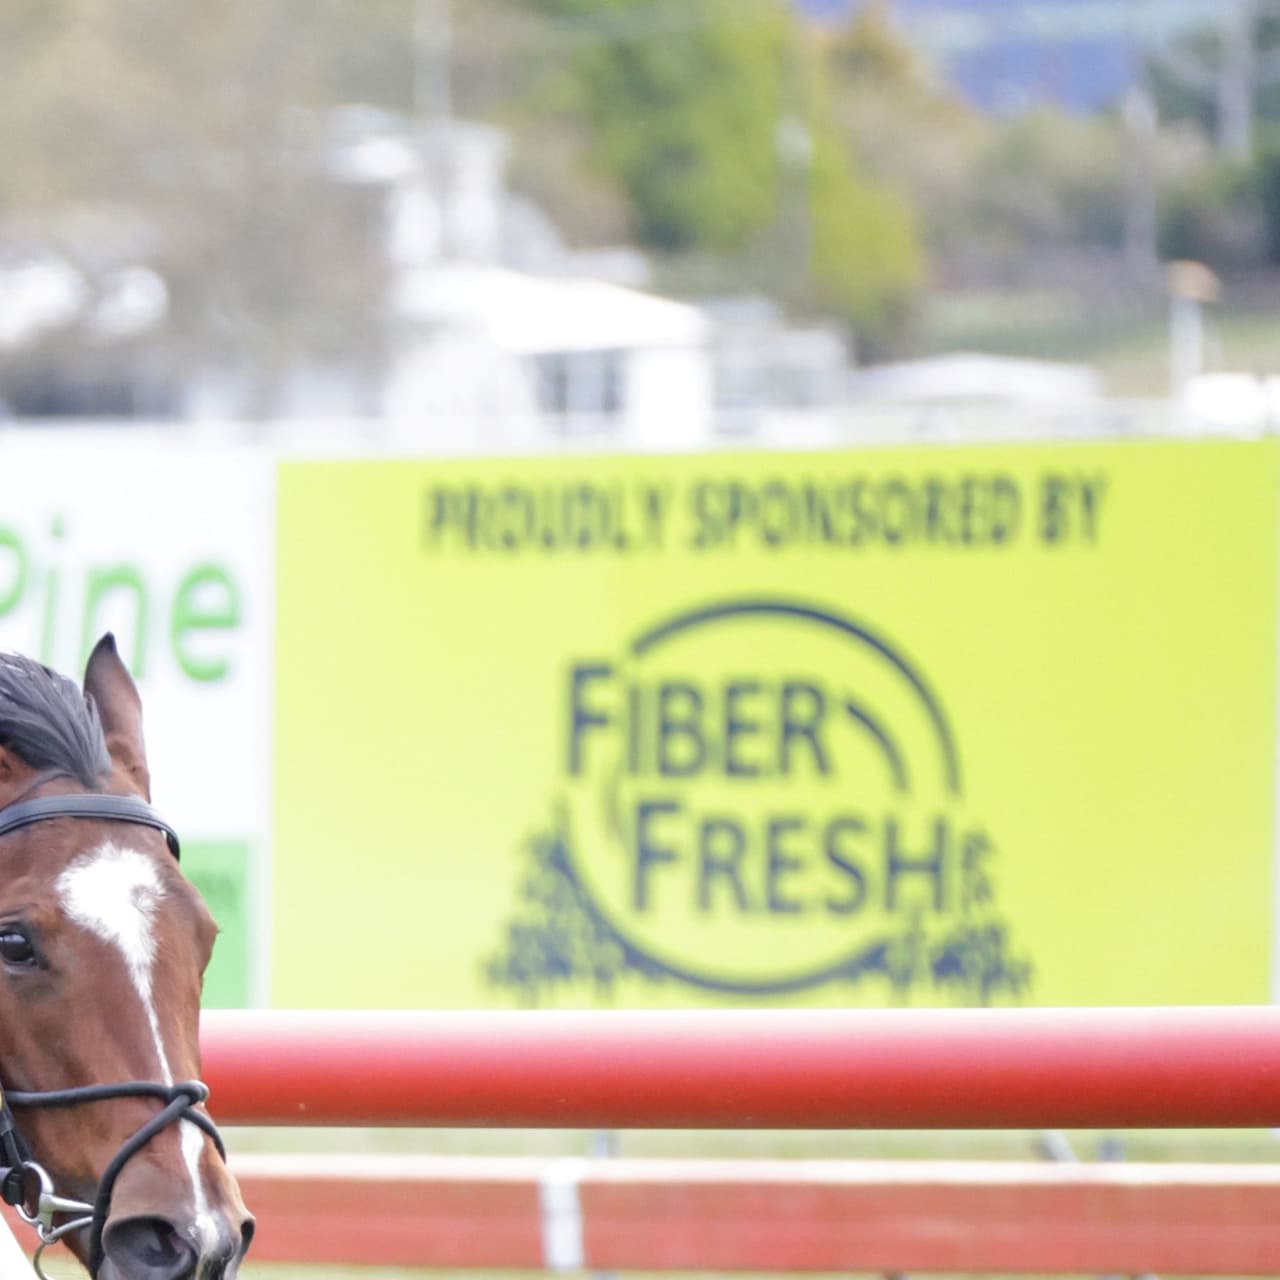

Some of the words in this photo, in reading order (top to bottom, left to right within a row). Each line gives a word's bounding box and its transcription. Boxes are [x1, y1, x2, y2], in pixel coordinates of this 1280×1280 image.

[423, 478, 668, 554] PROUDLY
[690, 472, 1024, 552] SPONSORED
[1038, 468, 1108, 548] BY
[564, 658, 834, 780] FIBER
[632, 798, 948, 914] FRESH
